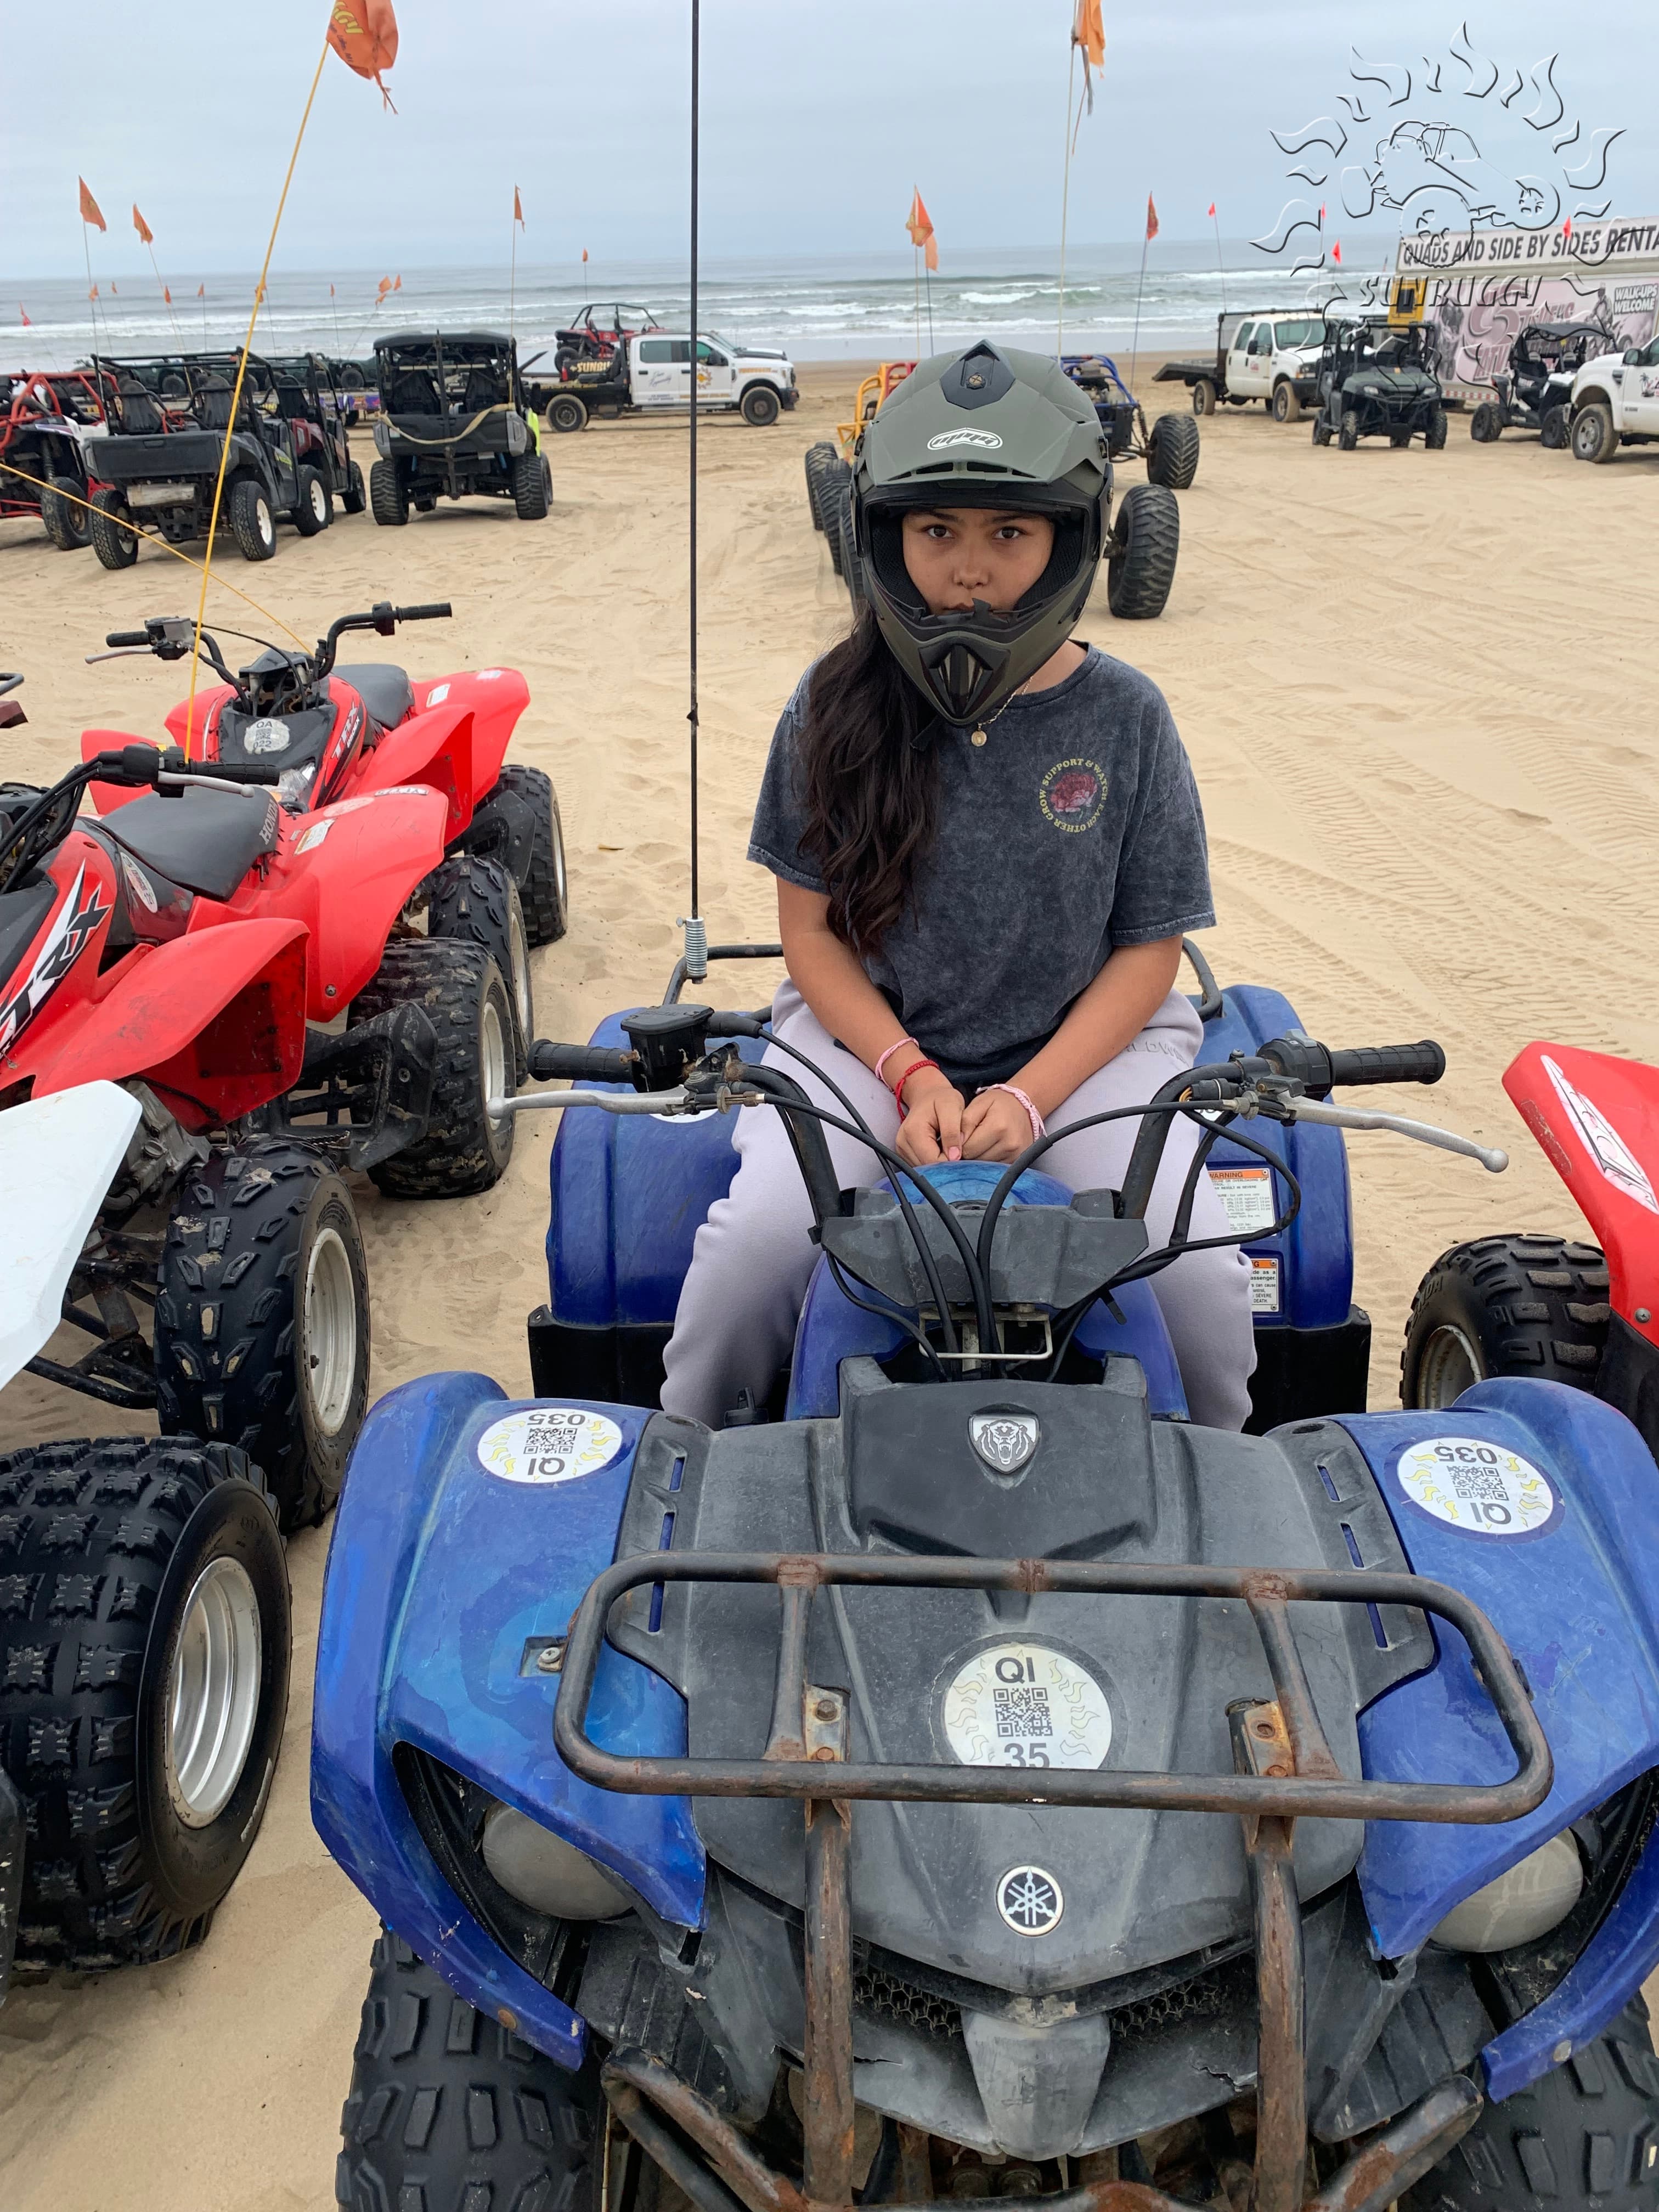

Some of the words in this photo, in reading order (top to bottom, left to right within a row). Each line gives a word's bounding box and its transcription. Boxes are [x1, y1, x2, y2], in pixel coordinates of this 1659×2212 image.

[1452, 239, 1485, 262] AND
[1488, 234, 1525, 261] SIDE
[1527, 233, 1550, 258] BY
[1551, 228, 1601, 257] SIDES
[1615, 283, 1658, 301] WALK-UPS
[1614, 297, 1656, 315] WELCOME
[1042, 758, 1084, 786] SUPPORT
[1093, 764, 1108, 800] WATCH
[1039, 789, 1054, 820] GROW
[1087, 803, 1104, 828] EACH
[1053, 818, 1086, 833] OTHER
[527, 1413, 586, 1425] 035
[1434, 1446, 1498, 1464] 035
[1003, 1742, 1050, 1768] 35
